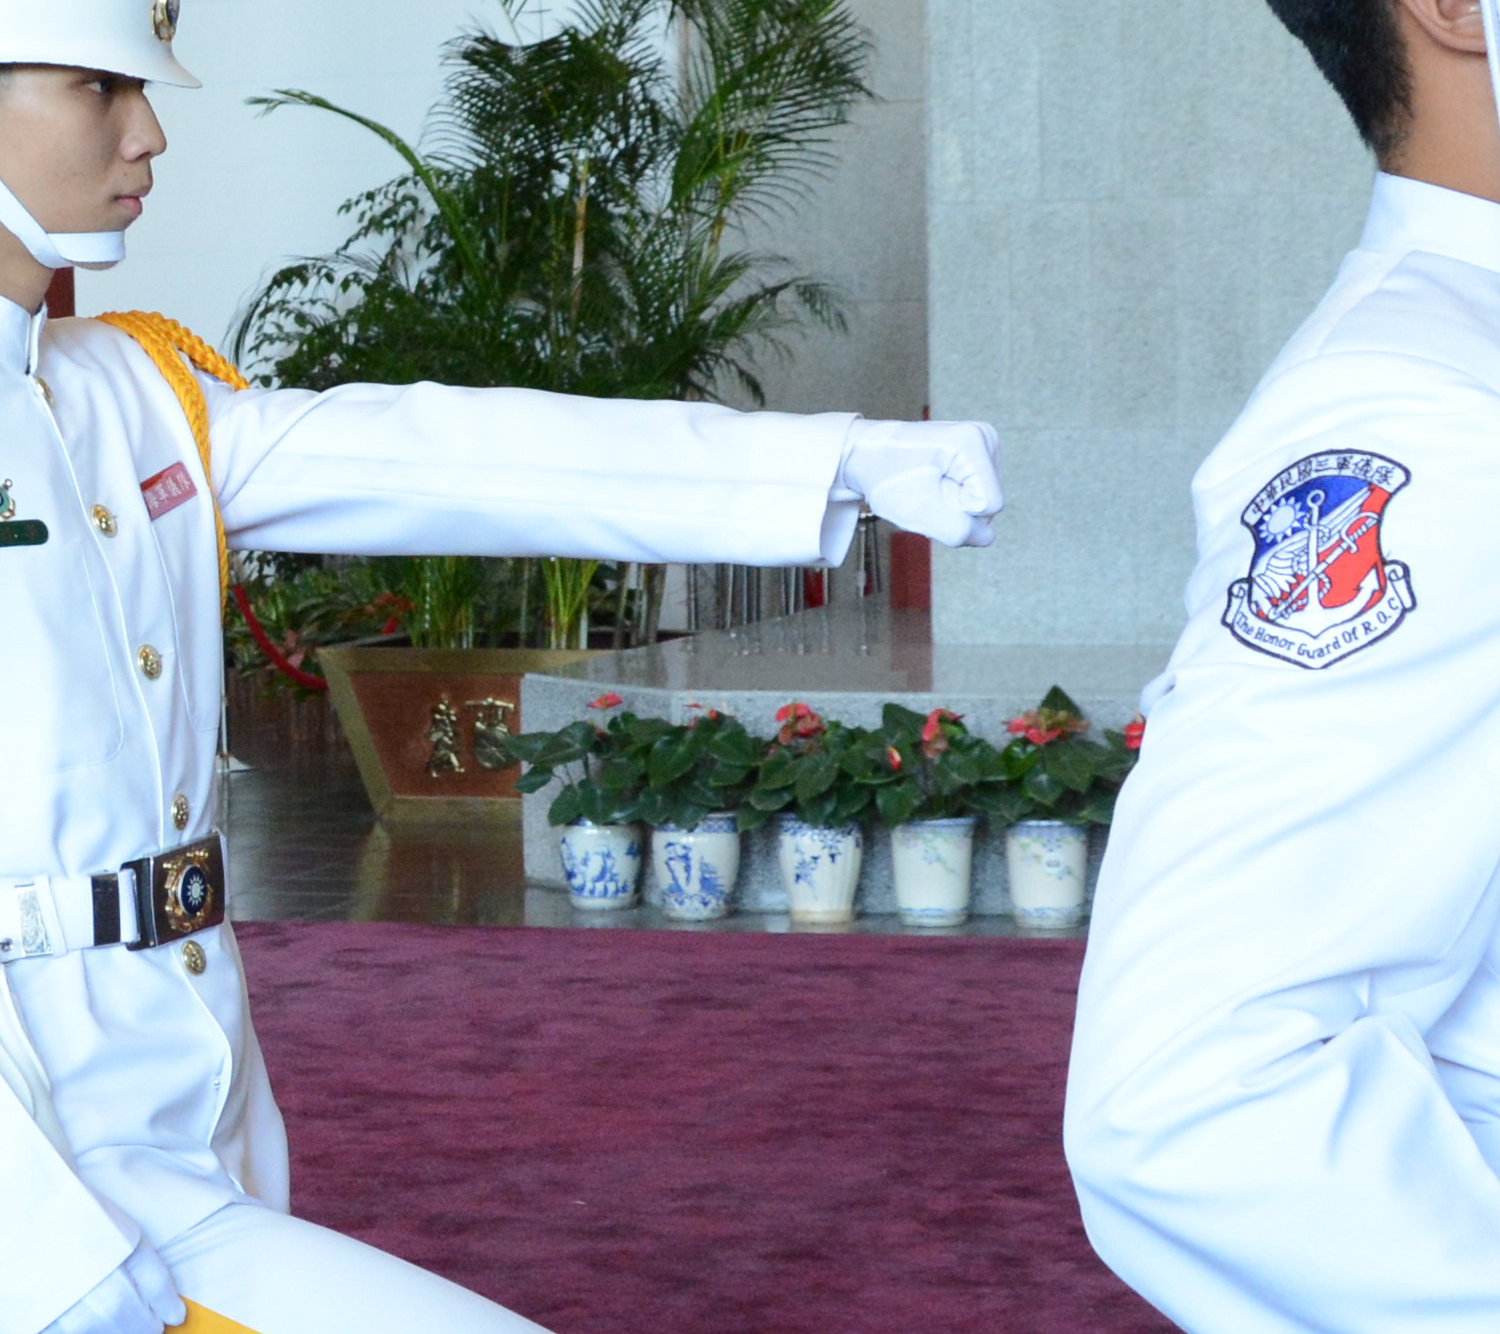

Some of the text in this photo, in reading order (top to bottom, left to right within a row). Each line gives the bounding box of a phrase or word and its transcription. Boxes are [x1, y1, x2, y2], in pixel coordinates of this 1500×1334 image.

[1252, 455, 1395, 514] 中華民國三軍儀隊
[1237, 611, 1253, 635] The
[1254, 627, 1295, 650] Honor
[1298, 637, 1341, 658] Guard
[1342, 627, 1359, 643] Of
